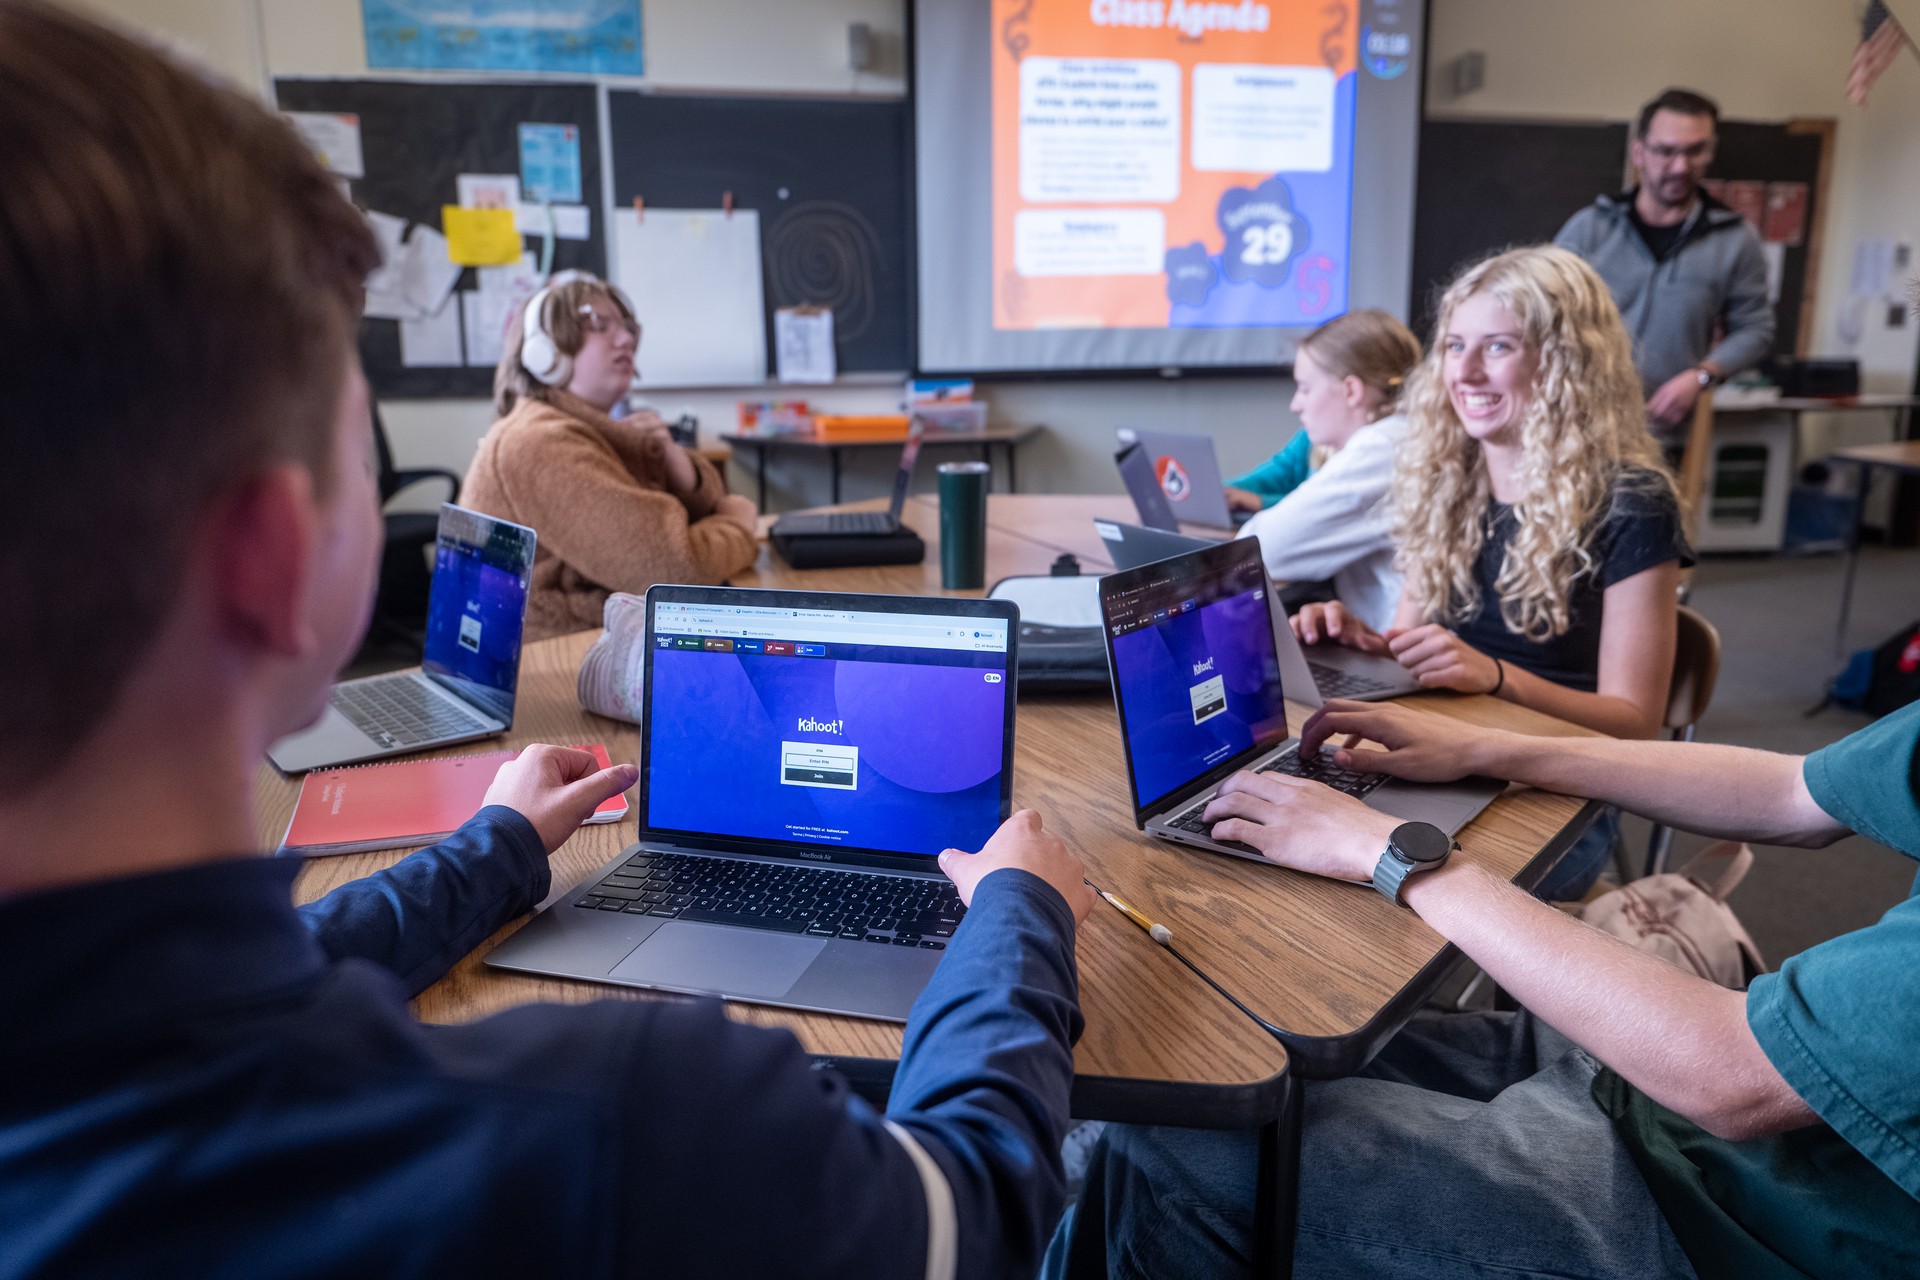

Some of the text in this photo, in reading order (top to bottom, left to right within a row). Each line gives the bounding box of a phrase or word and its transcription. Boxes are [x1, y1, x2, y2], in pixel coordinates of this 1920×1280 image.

[1089, 0, 1270, 37] Class Agenda
[1240, 223, 1293, 266] 29
[1193, 657, 1214, 676] Kahoot!
[798, 716, 843, 736] Kahoot!
